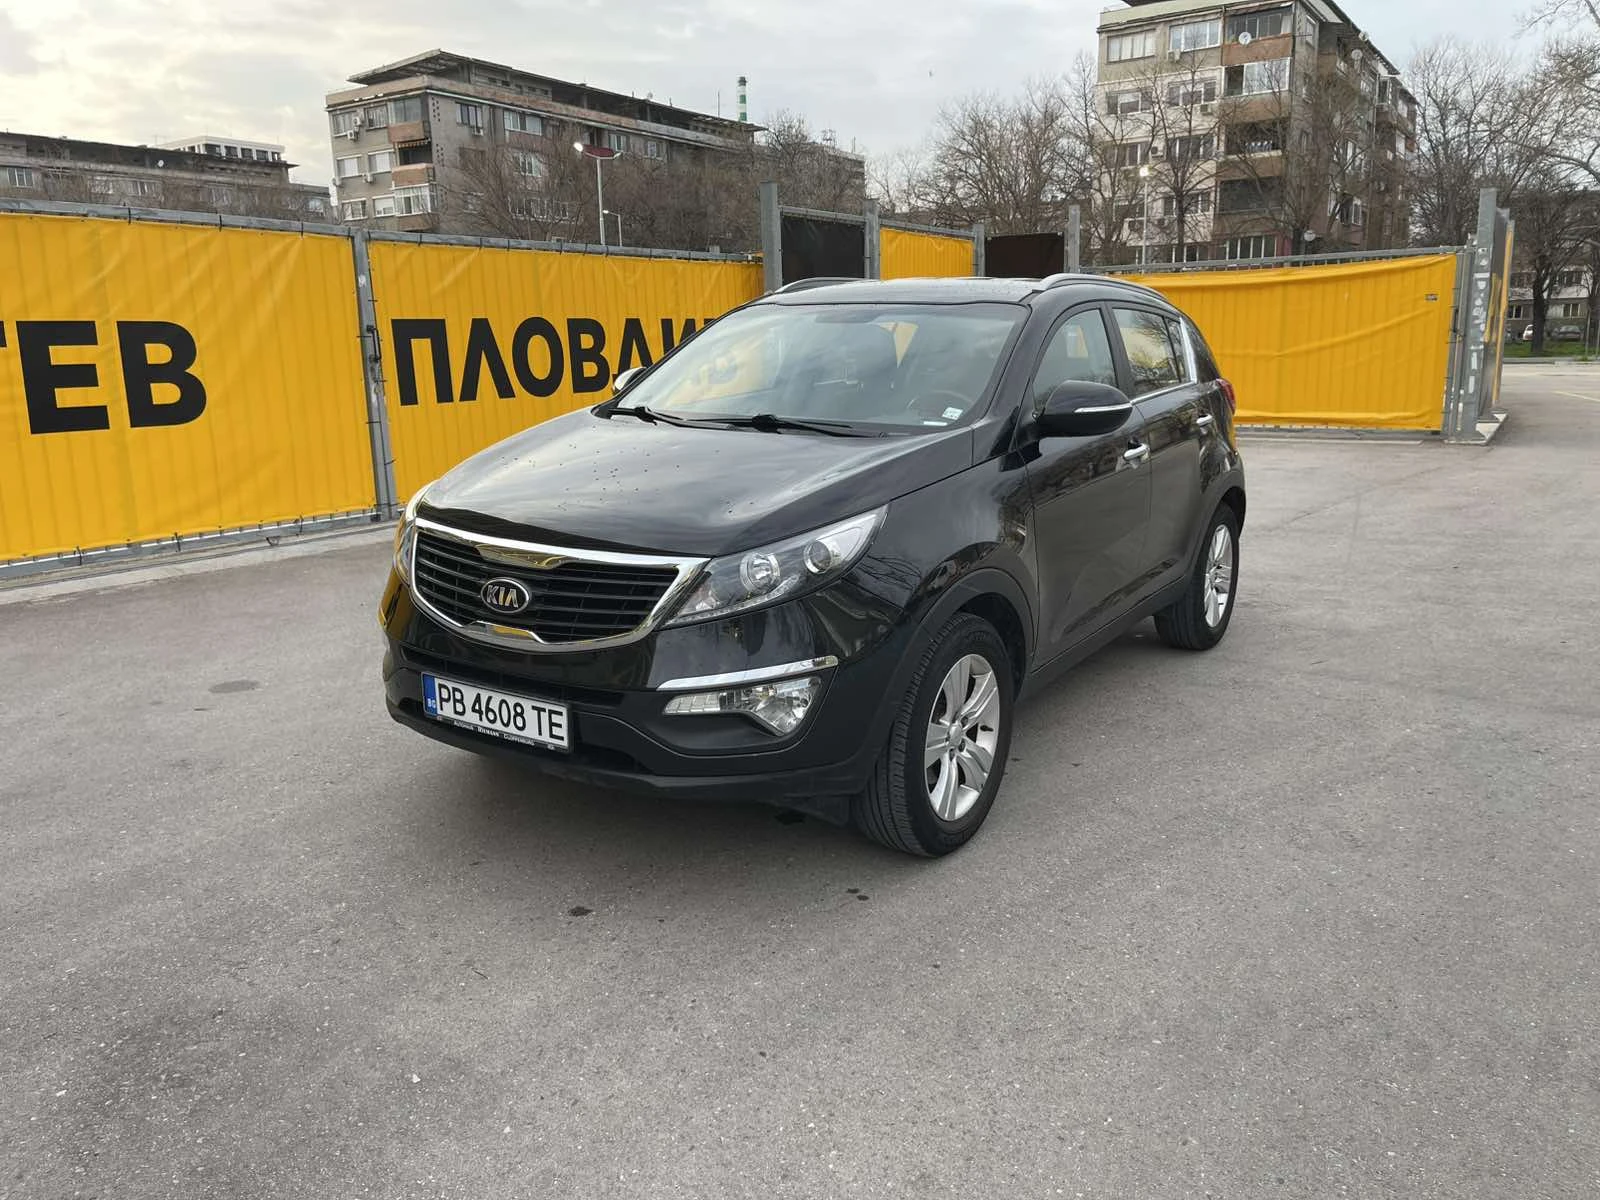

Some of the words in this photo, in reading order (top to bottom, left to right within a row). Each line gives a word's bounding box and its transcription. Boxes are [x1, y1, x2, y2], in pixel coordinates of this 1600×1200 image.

[0, 318, 207, 434] ЕВ
[391, 316, 718, 406] ПЛОВД
[486, 584, 519, 608] KIA
[438, 683, 466, 716] PB
[471, 692, 527, 732] 4608
[531, 704, 565, 742] TE
